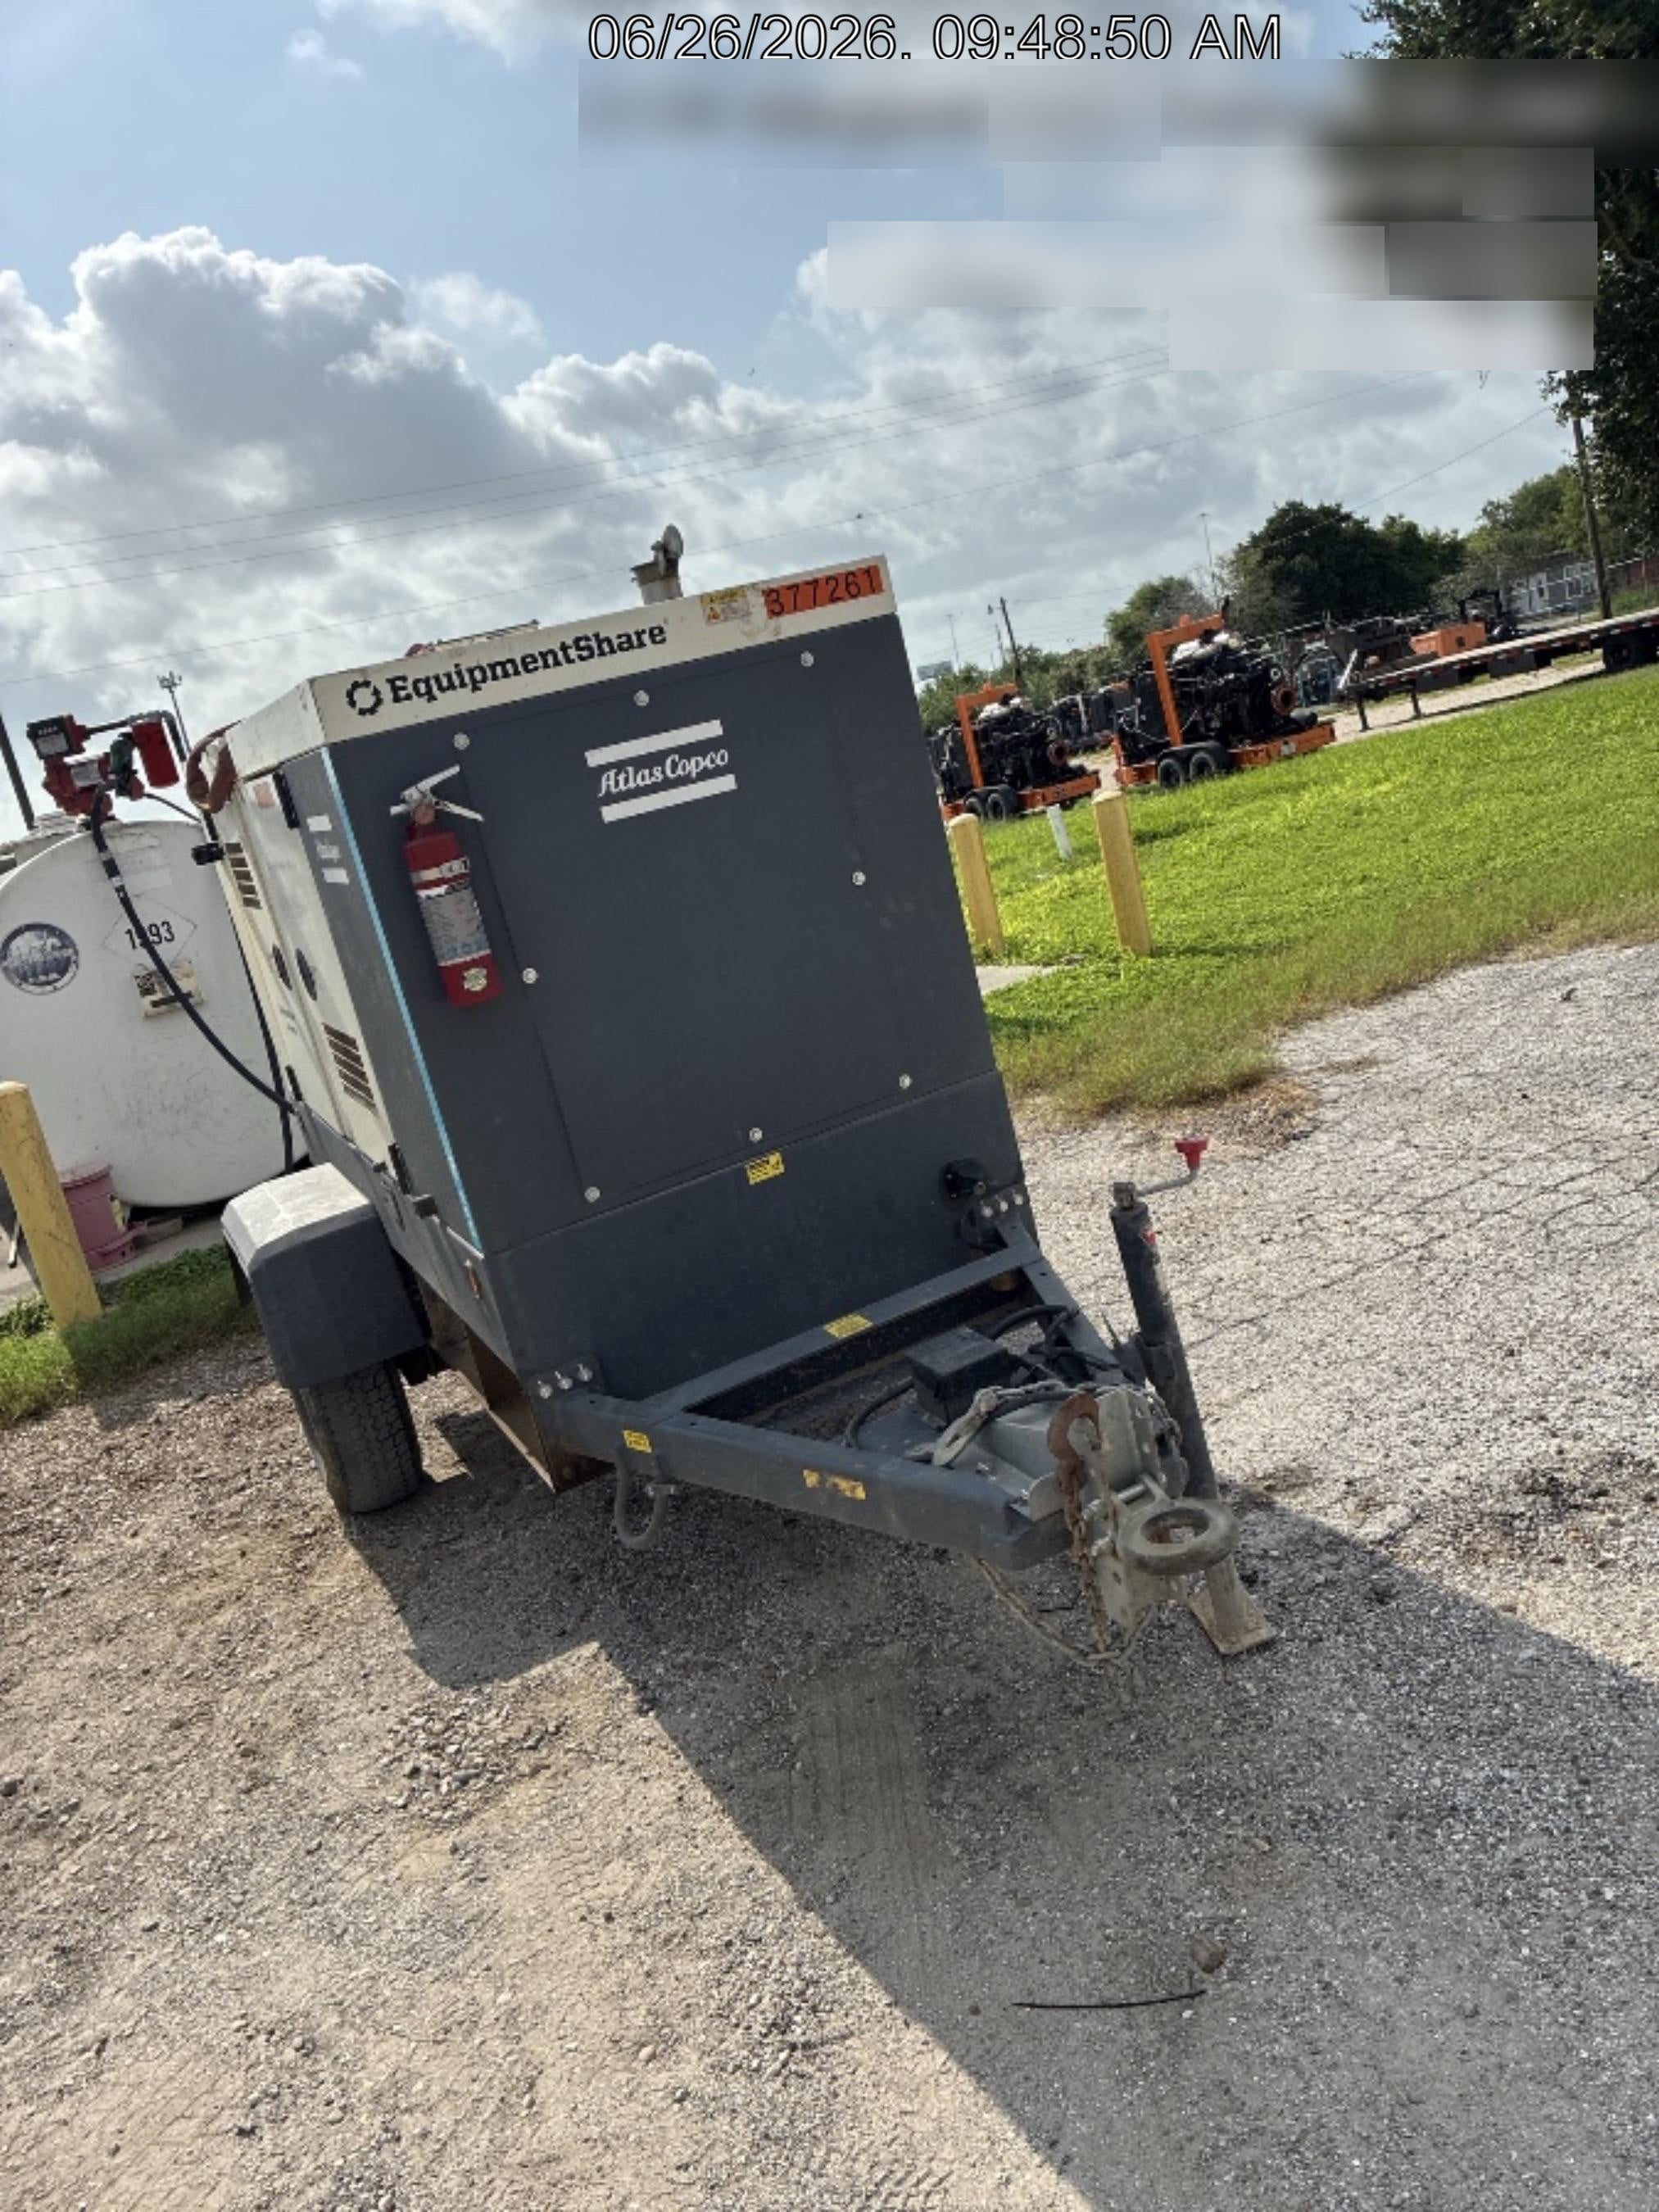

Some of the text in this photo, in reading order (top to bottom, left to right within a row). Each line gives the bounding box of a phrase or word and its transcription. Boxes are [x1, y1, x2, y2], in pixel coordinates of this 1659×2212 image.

[765, 567, 877, 618] 377261
[386, 623, 667, 705] EquipmentShare
[597, 749, 729, 798] Atlas Copco
[125, 920, 175, 950] 193
